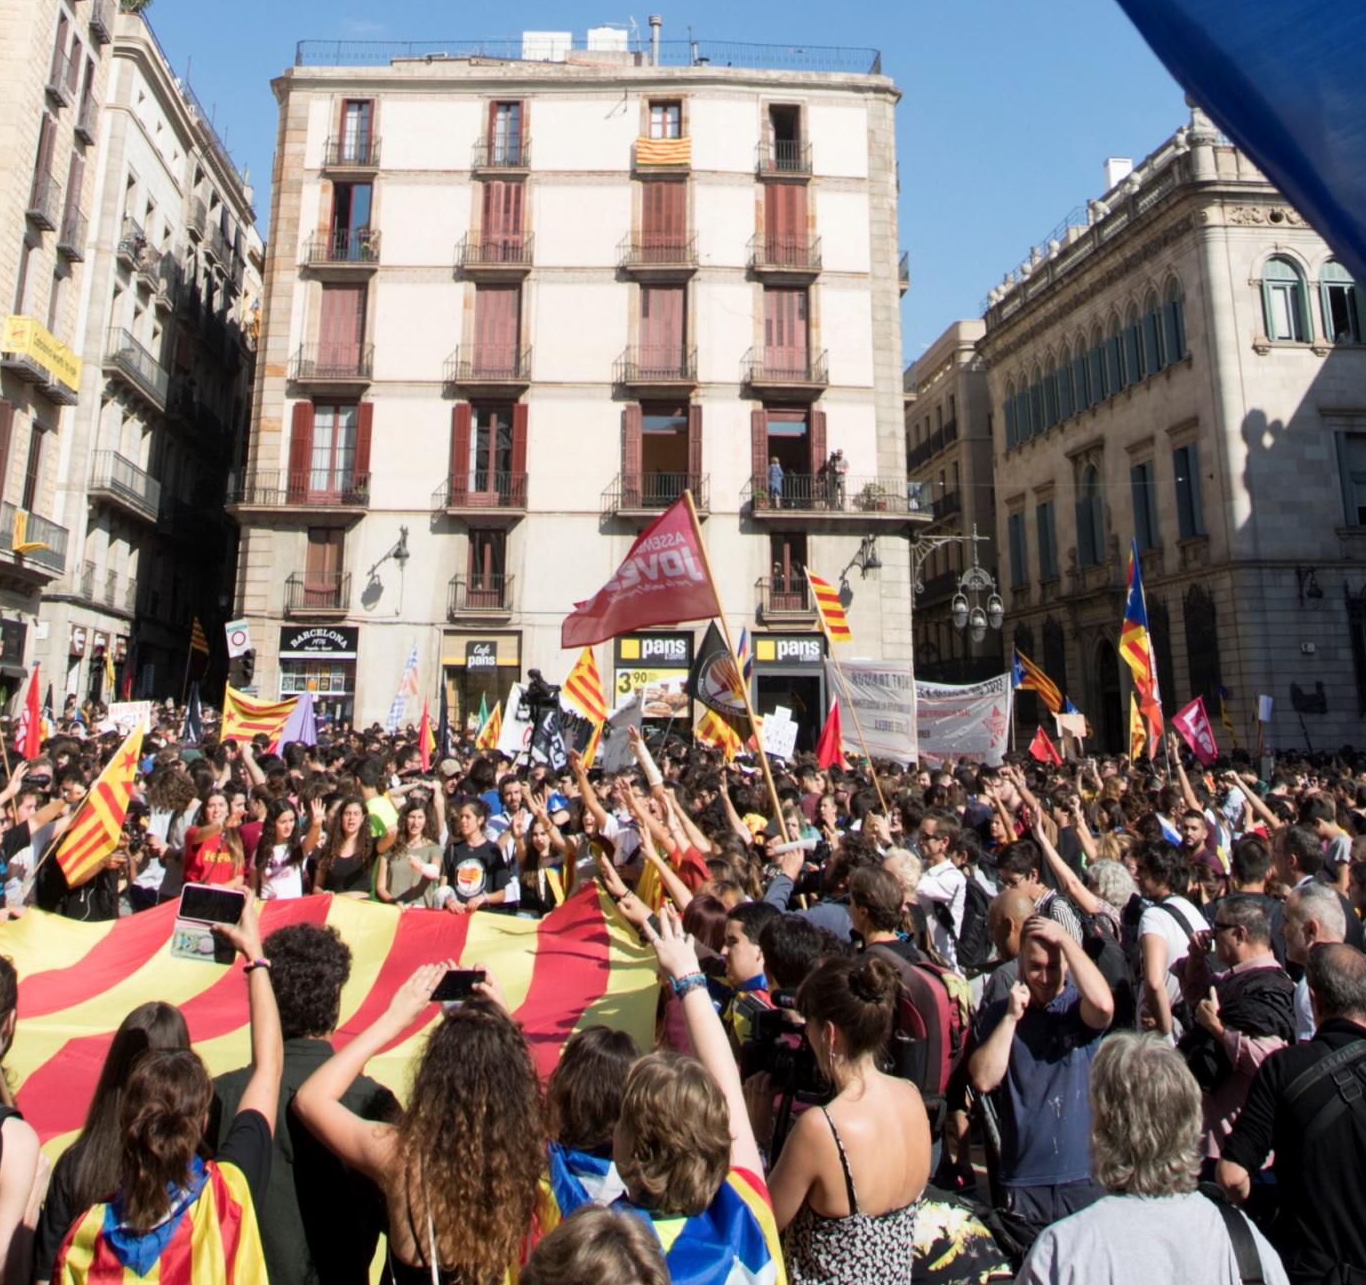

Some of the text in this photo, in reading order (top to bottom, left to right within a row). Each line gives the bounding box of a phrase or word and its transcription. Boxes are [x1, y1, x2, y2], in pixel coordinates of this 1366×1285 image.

[290, 629, 348, 649] BARCELONA
[641, 638, 687, 660] pans
[776, 640, 821, 661] pans
[467, 655, 496, 669] pans
